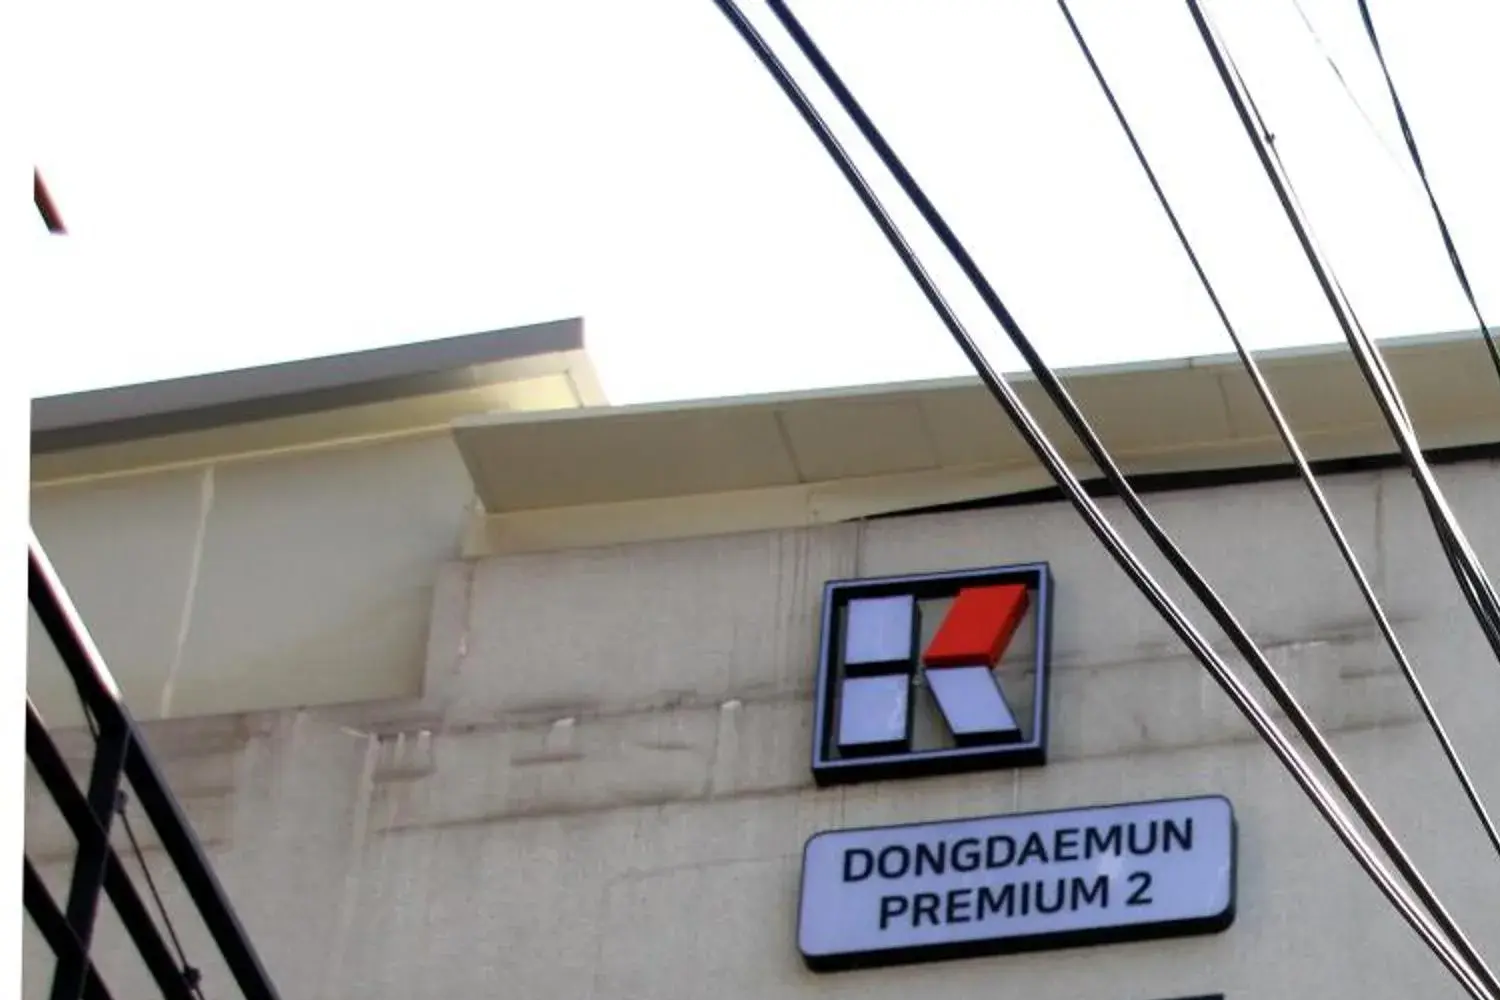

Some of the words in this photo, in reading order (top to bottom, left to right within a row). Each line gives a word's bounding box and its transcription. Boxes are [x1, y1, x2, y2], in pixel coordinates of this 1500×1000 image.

[838, 584, 1029, 755] K
[843, 818, 1194, 883] DONGDAEMUN
[878, 876, 1108, 930] PREMIUM
[1125, 871, 1153, 906] 2
